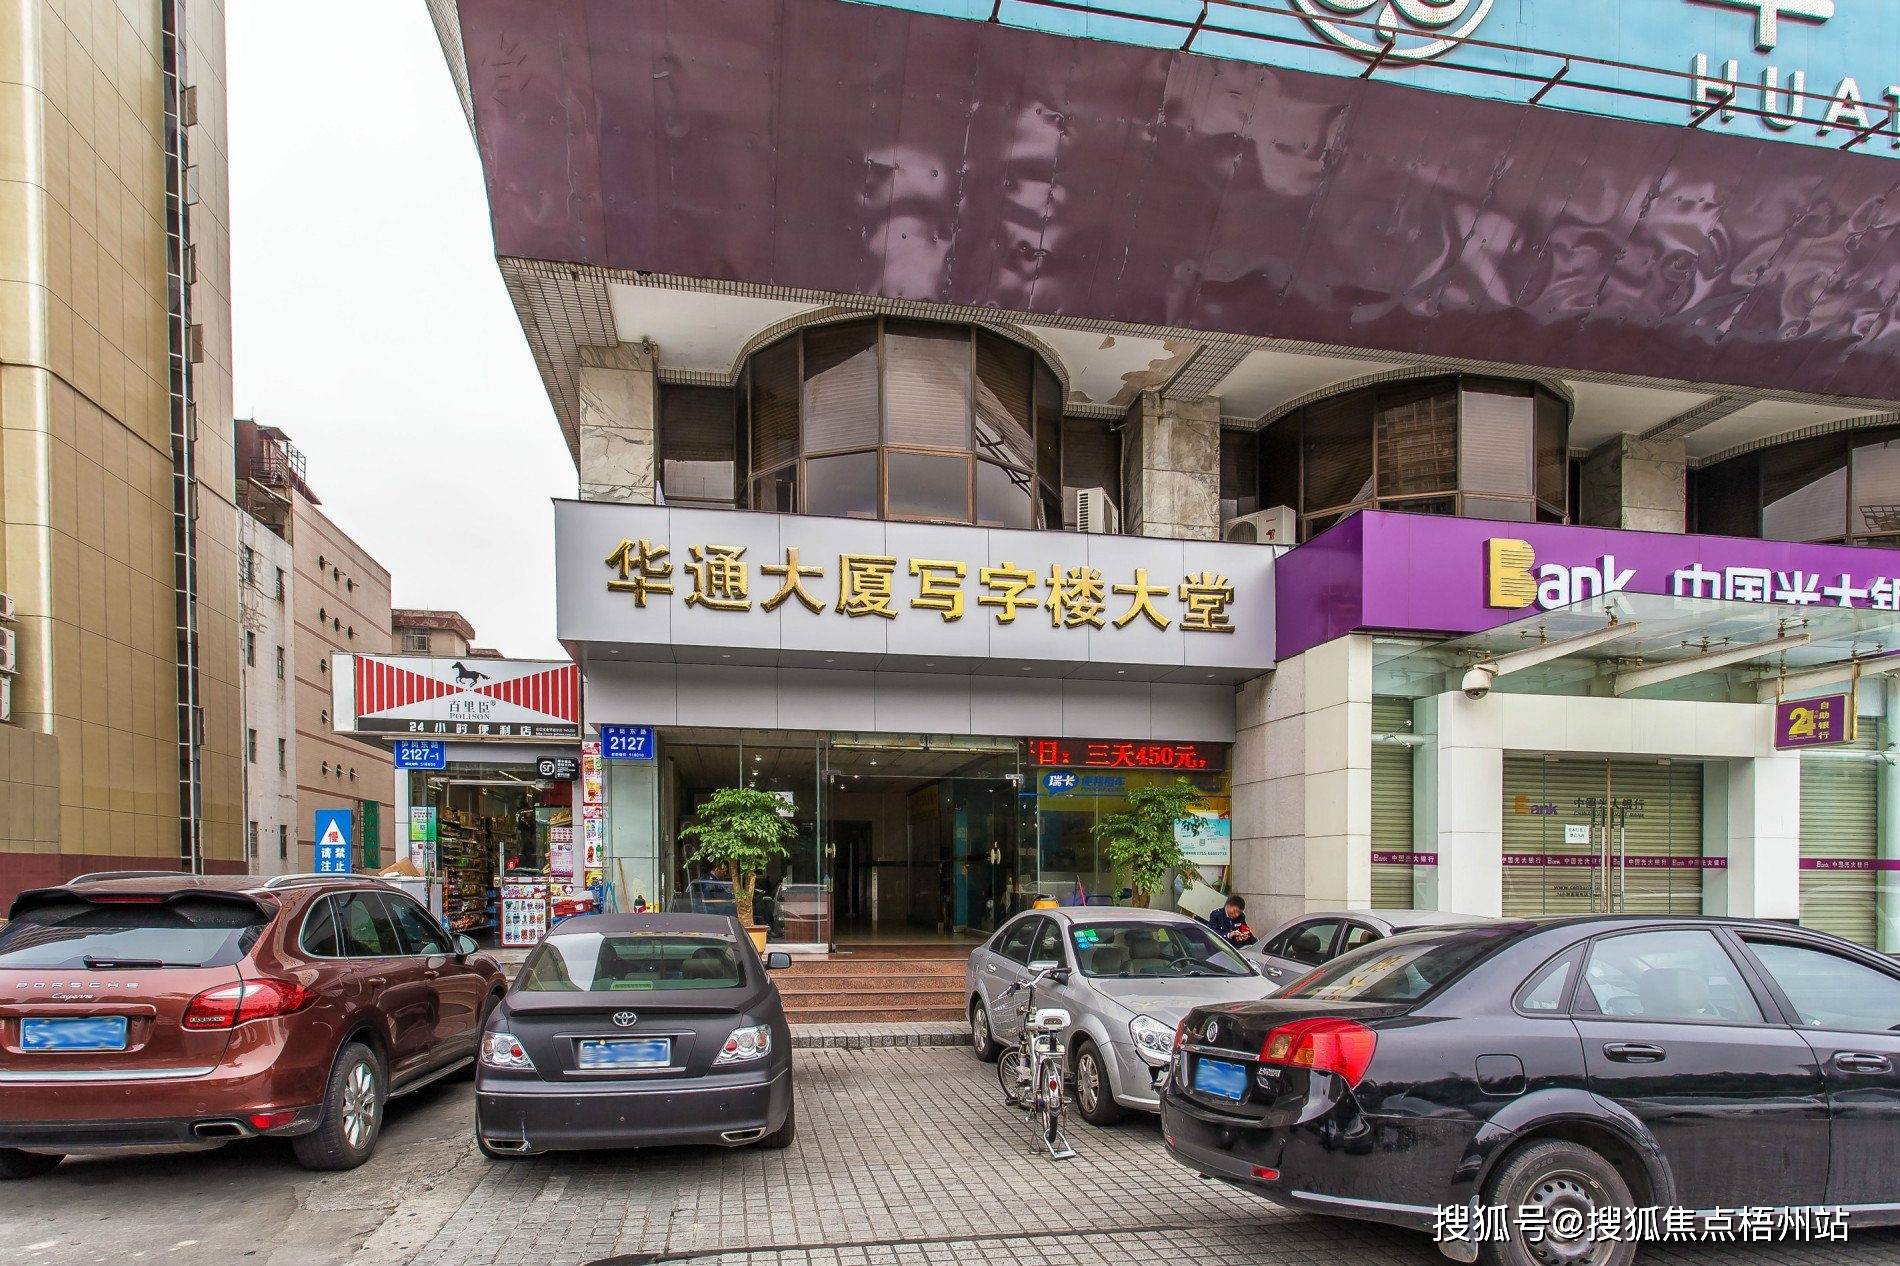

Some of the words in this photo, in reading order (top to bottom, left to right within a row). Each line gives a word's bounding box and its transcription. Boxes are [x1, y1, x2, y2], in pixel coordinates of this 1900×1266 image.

[1488, 537, 1638, 610] Bank
[605, 537, 1236, 633] 华通大厦写字楼大堂
[449, 700, 490, 714] 百里臣
[450, 712, 491, 721] POLISON
[1788, 707, 1815, 736] 24
[1818, 701, 1831, 740] 自助银行
[409, 721, 532, 737] 24小时便利店
[610, 736, 645, 751] 2127
[401, 748, 440, 760] 2127-1
[1514, 794, 1558, 816] Bank
[327, 831, 339, 843] 慢
[15, 982, 140, 990] PORSCHE
[51, 992, 94, 1002] Cayenne
